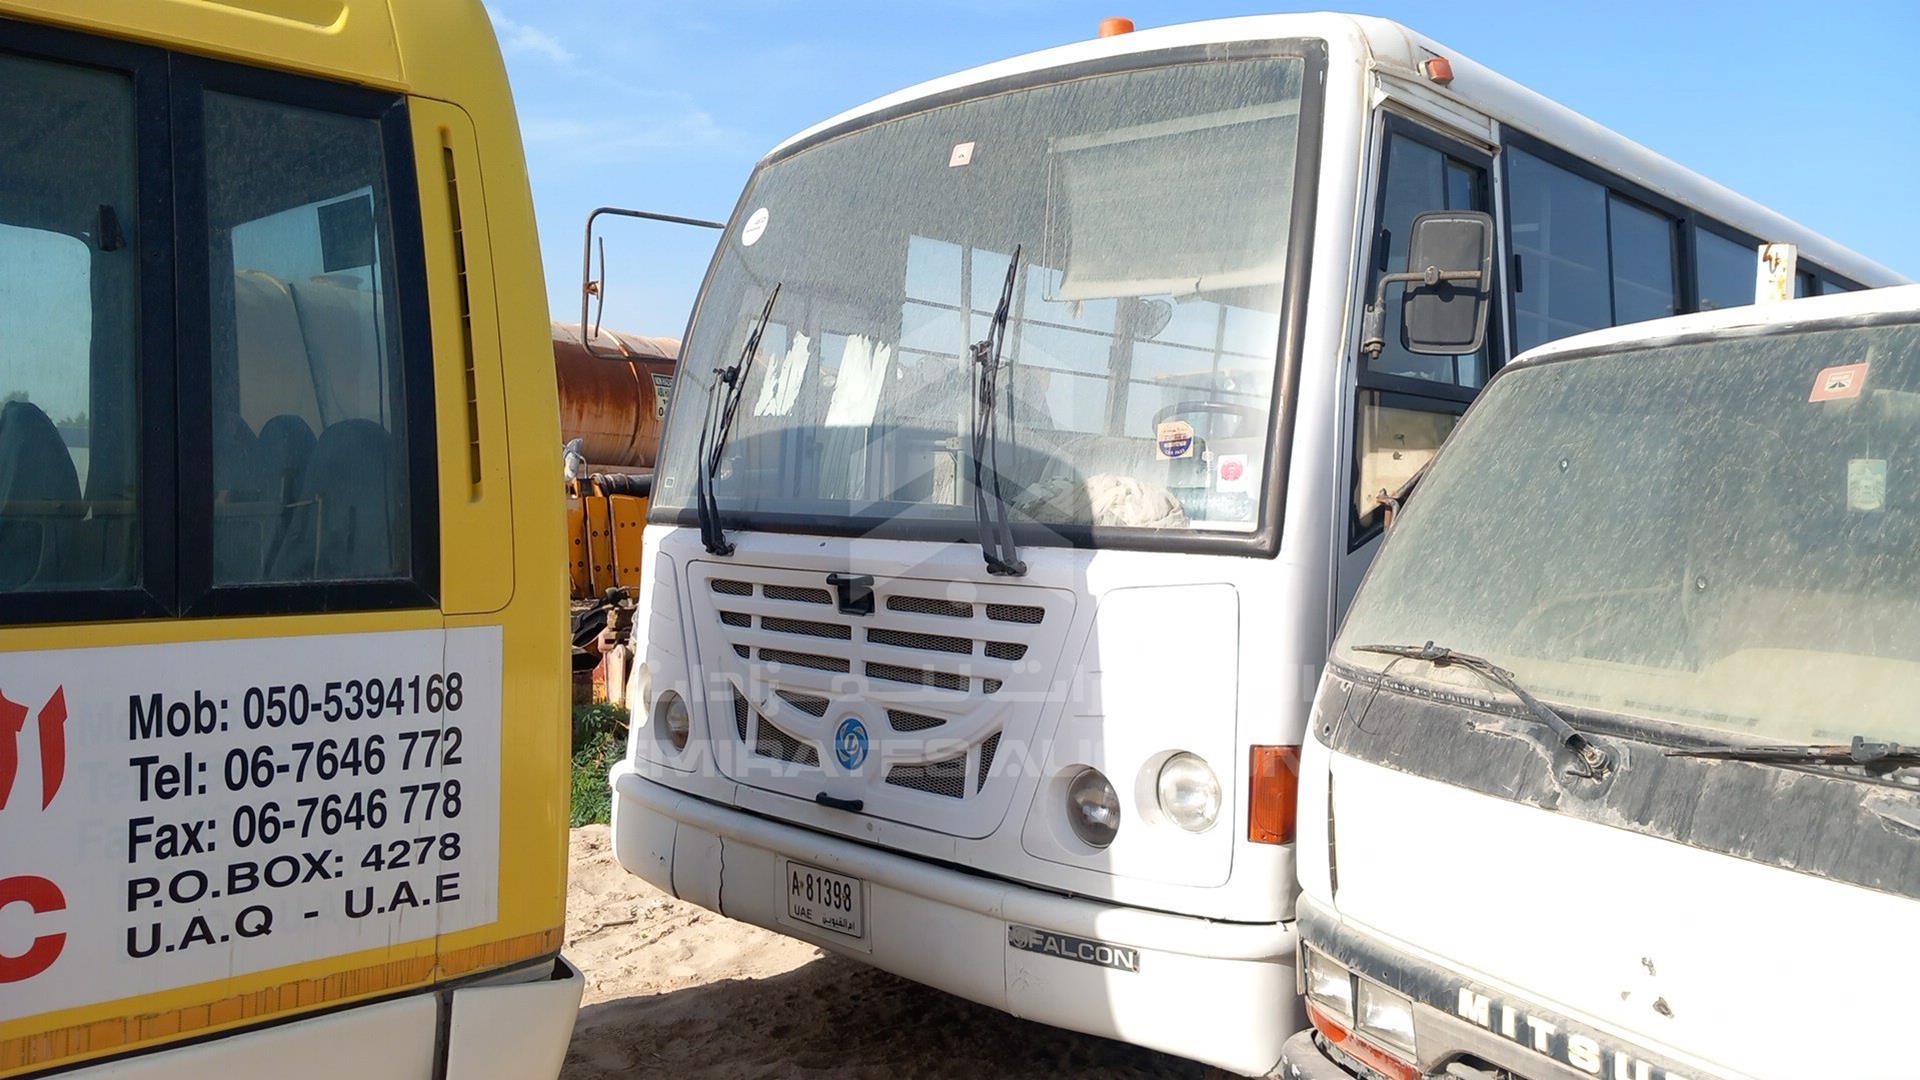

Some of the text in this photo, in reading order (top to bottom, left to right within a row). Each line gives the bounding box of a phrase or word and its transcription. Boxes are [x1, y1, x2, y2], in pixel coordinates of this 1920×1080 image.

[129, 672, 463, 740] Mob: 050-5394168
[130, 727, 462, 802] Tel: 06-7646 772
[128, 780, 462, 864] Fax: 06-7646 778
[127, 832, 461, 912] P.O.BOX: 4278
[806, 873, 852, 912] 81398
[126, 905, 273, 959] U.A.Q
[344, 872, 460, 919] U.A.E
[794, 904, 813, 920] UAE
[1027, 931, 1135, 969] FALCON
[1458, 986, 1684, 1080] MITSU
